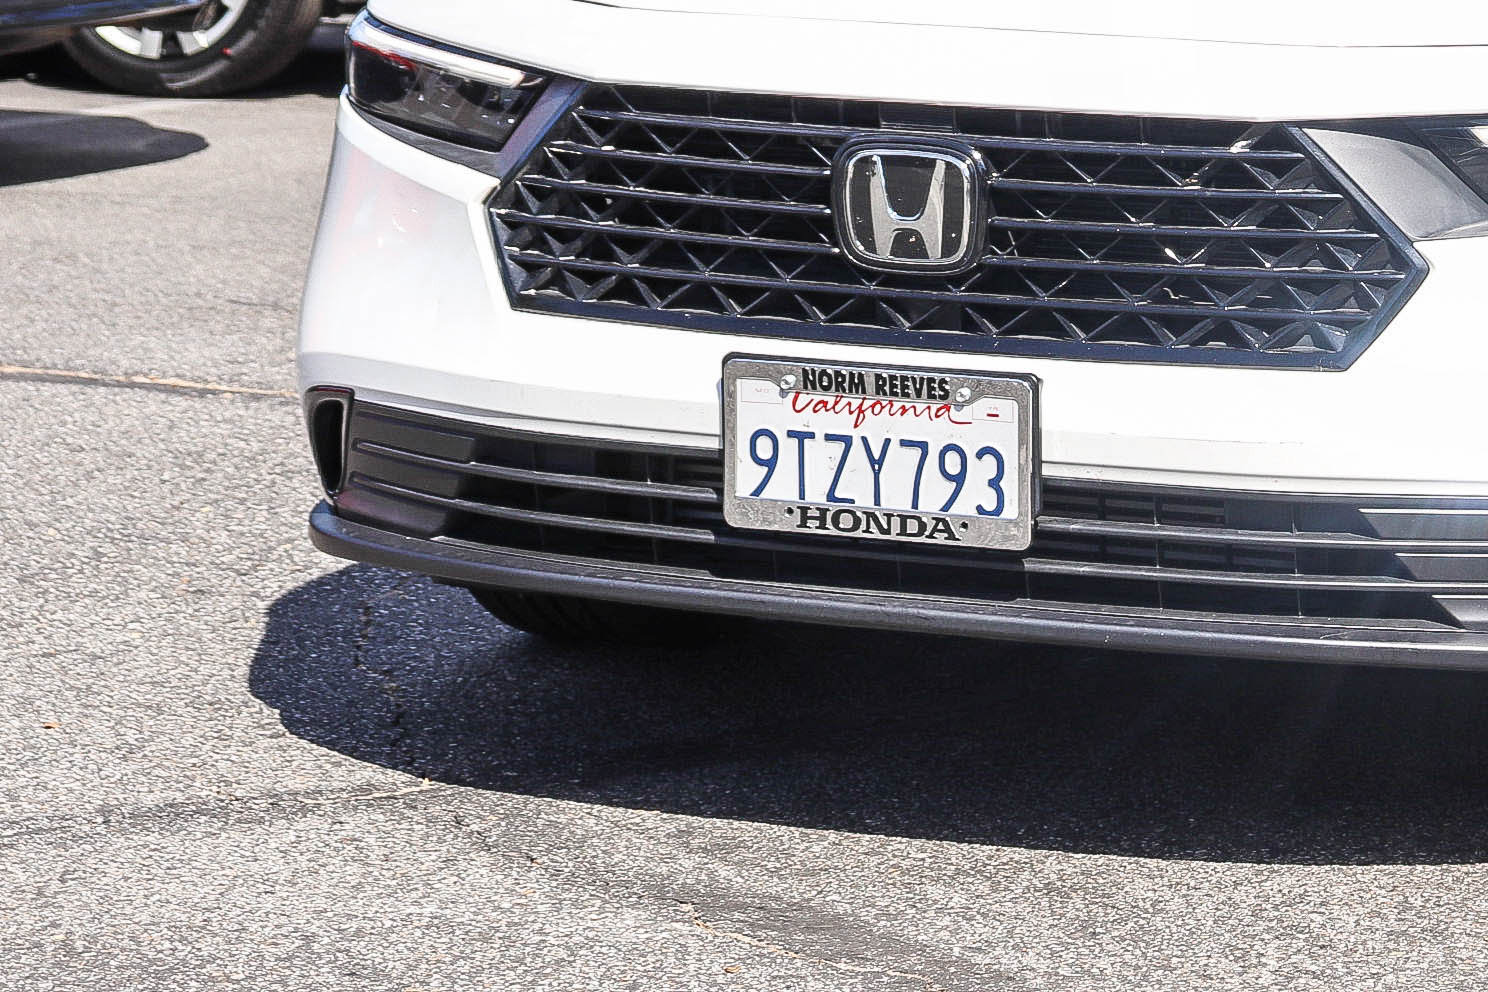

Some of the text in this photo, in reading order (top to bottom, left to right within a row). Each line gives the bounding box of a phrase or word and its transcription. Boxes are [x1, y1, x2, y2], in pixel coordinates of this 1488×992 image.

[801, 367, 950, 401] NORM REEVES
[791, 391, 973, 429] California
[749, 428, 1006, 518] 9TZY793
[795, 505, 962, 542] HONDA
